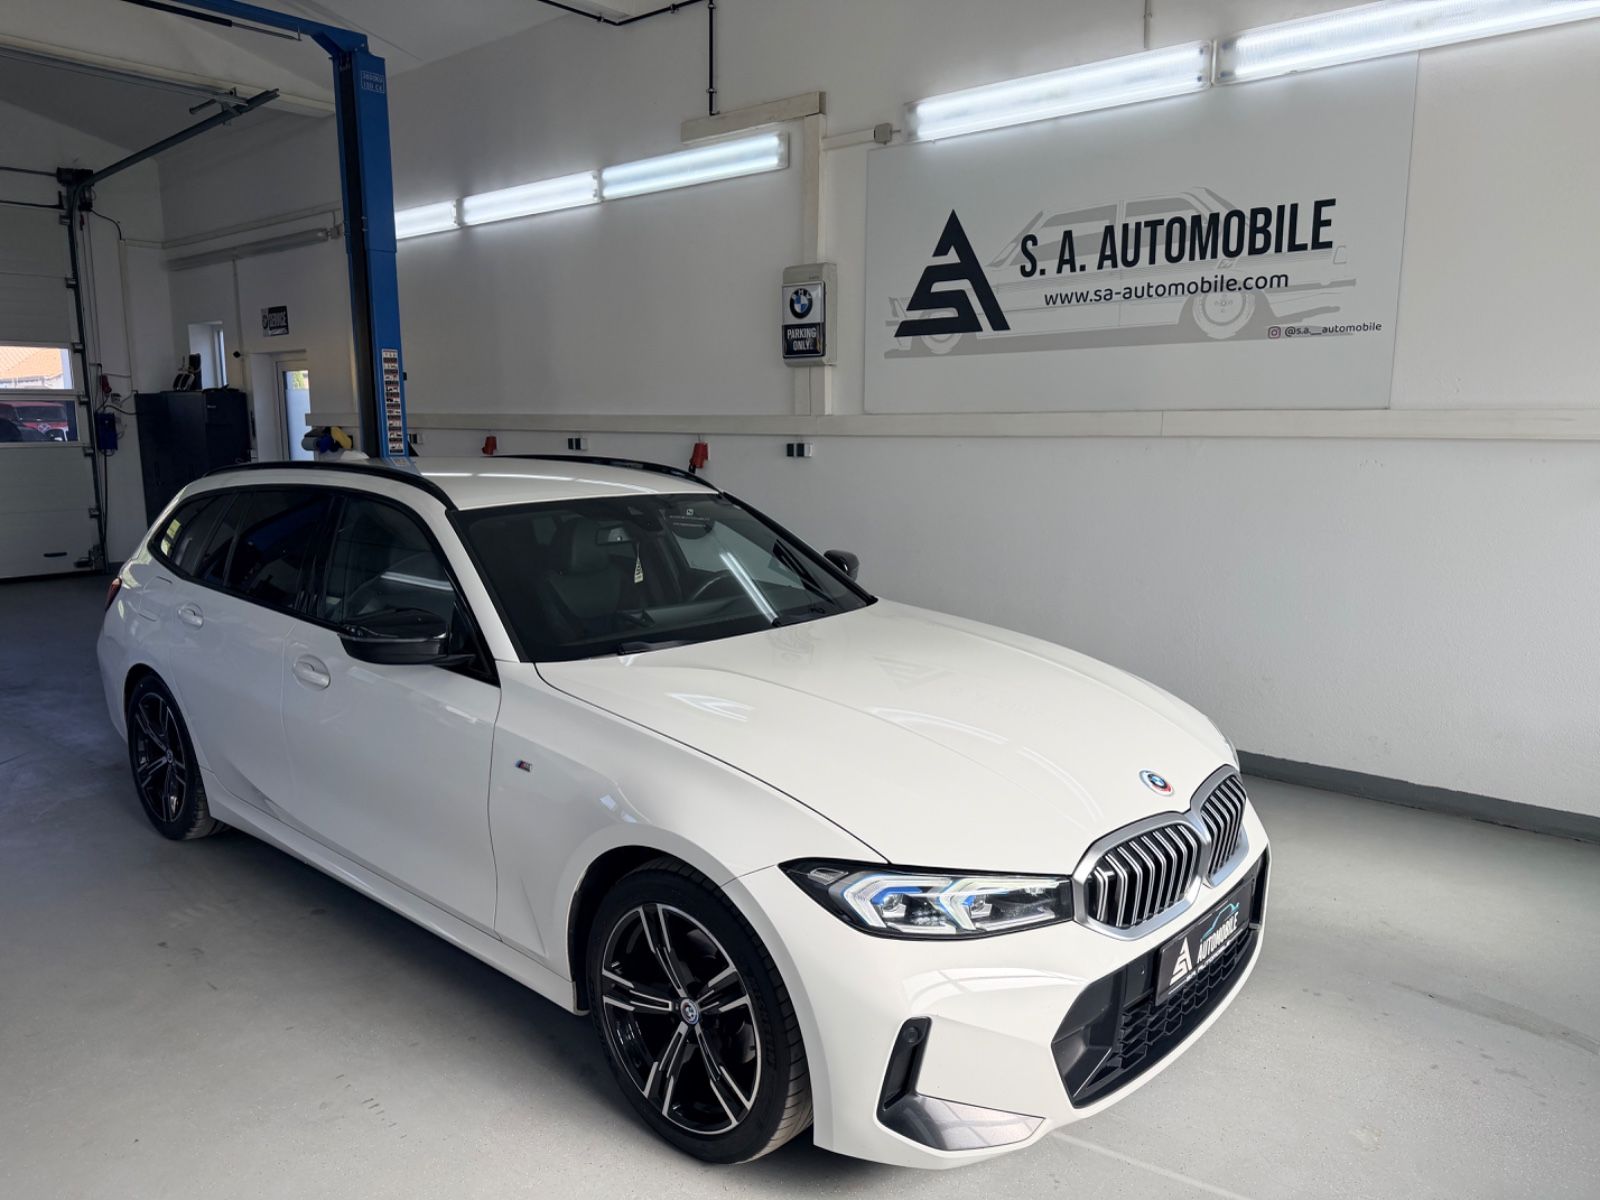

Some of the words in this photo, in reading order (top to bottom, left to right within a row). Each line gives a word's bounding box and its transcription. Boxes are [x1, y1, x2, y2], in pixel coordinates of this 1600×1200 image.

[1020, 234, 1046, 278] S.
[1056, 230, 1086, 275] A.
[1097, 198, 1337, 271] AUTOMOBILE
[1044, 273, 1289, 306] www.sa-automobile.com
[787, 328, 817, 340] PARKING
[1196, 911, 1239, 964] AUTOMOBILE
